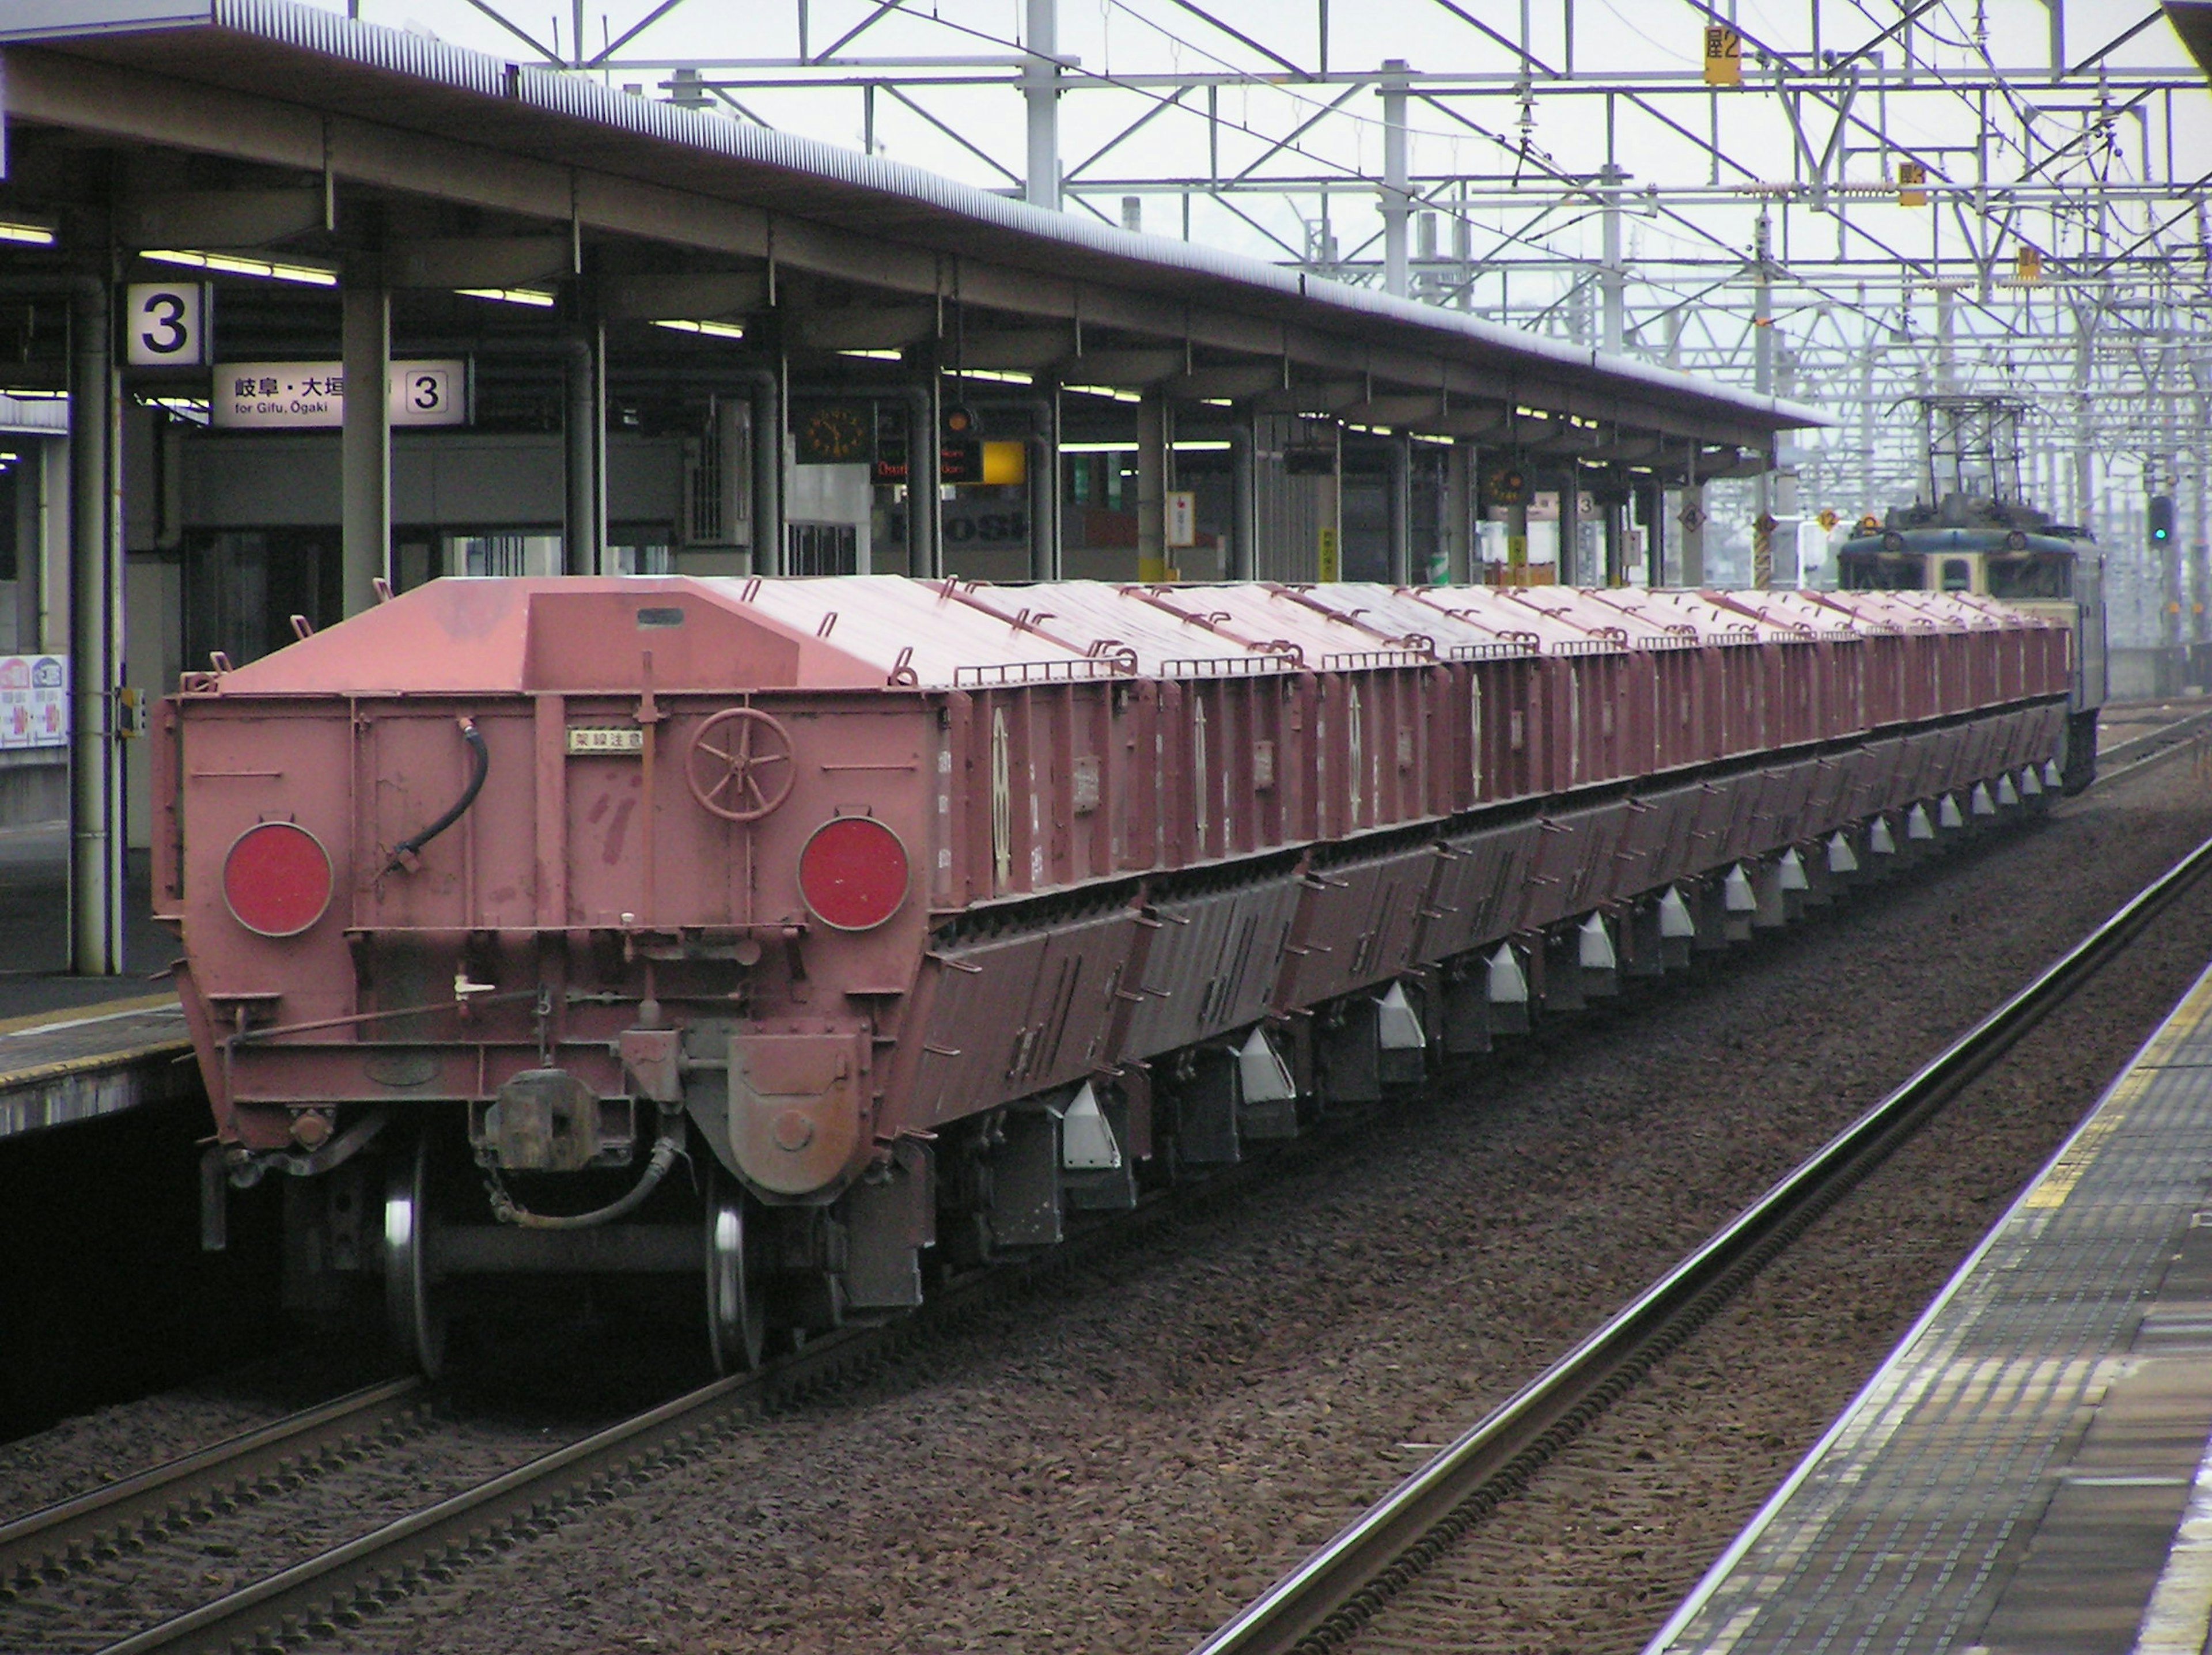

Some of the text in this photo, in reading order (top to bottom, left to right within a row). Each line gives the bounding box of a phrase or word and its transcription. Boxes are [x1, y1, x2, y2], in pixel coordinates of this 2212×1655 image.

[142, 293, 187, 353] 3
[234, 377, 344, 398] 岐阜・大垣
[414, 375, 440, 409] 3
[234, 400, 328, 415] for Gifu, Ōgaki
